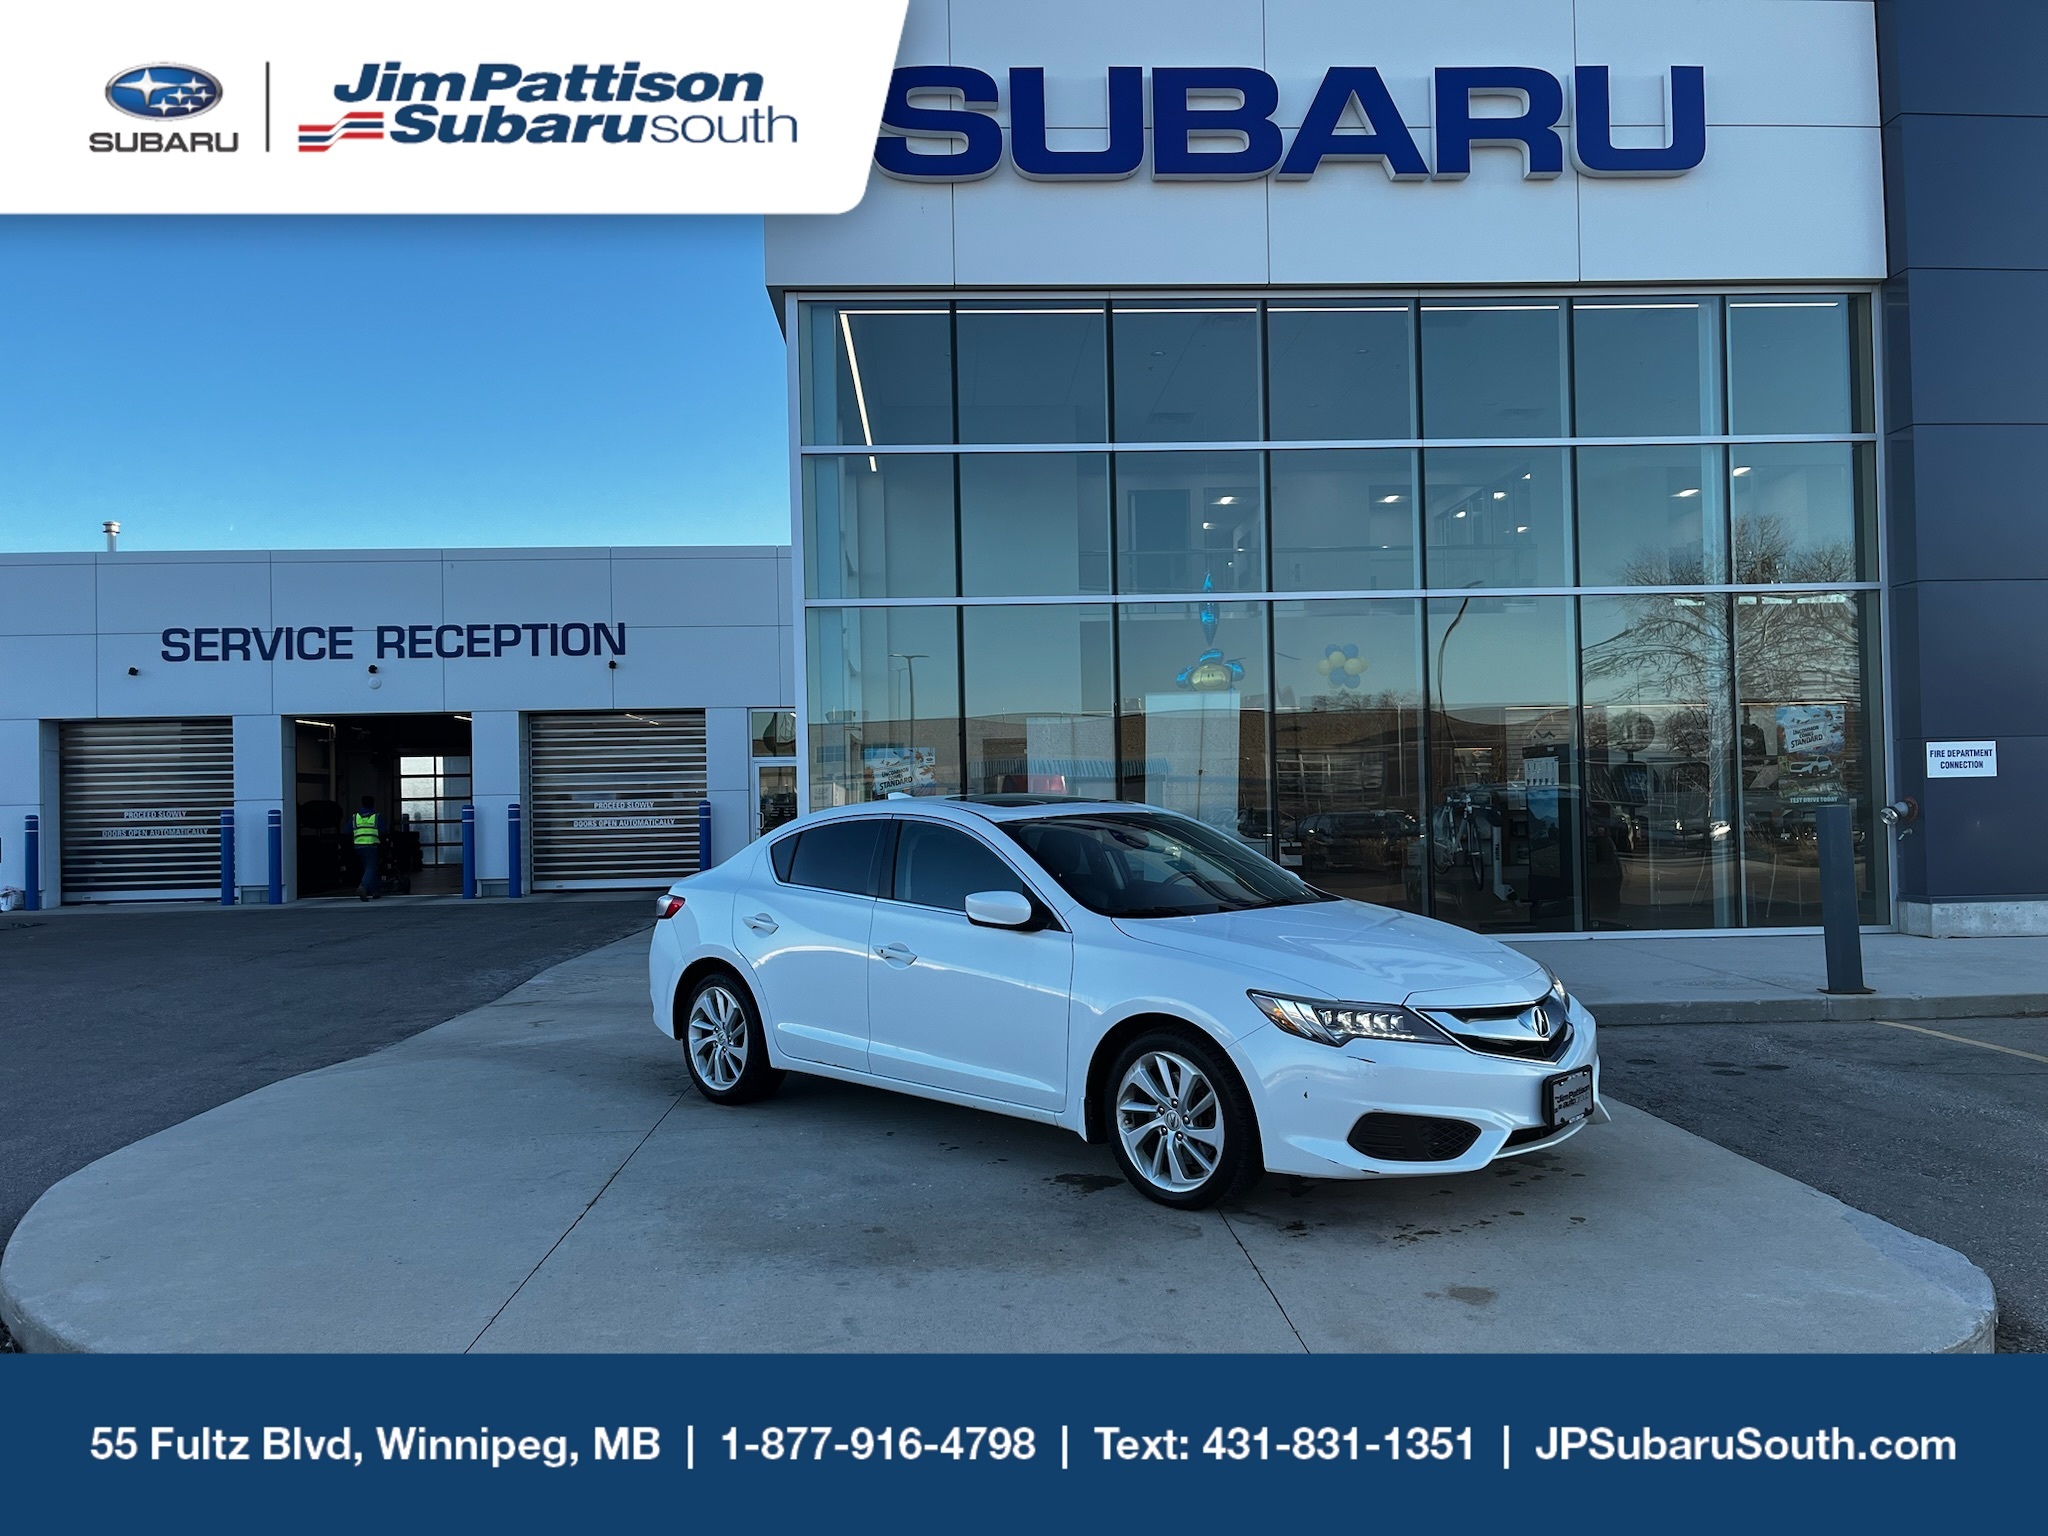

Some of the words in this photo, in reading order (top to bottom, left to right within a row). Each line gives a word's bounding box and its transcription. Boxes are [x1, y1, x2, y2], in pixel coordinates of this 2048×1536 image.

[873, 65, 1706, 180] SUBARU
[162, 626, 354, 662] SERVICE
[377, 622, 626, 659] RECEPTION
[1791, 734, 1823, 748] STANDARD
[1929, 749, 1945, 758] FIRE
[1947, 748, 1993, 757] DEPARTMENT
[1940, 760, 1984, 769] CONNECTION
[880, 776, 913, 790] STANDARD
[593, 801, 625, 809] PROCEED
[627, 801, 655, 809] SLOWLY
[124, 811, 157, 819] PROCEED
[158, 810, 187, 818] SLOWLY
[573, 820, 597, 828] DOORS
[618, 818, 675, 827] AUTOMATICALLY
[102, 829, 127, 838] DOORS
[128, 829, 148, 837] OPEN
[149, 827, 209, 836] AUTOMATICALLY
